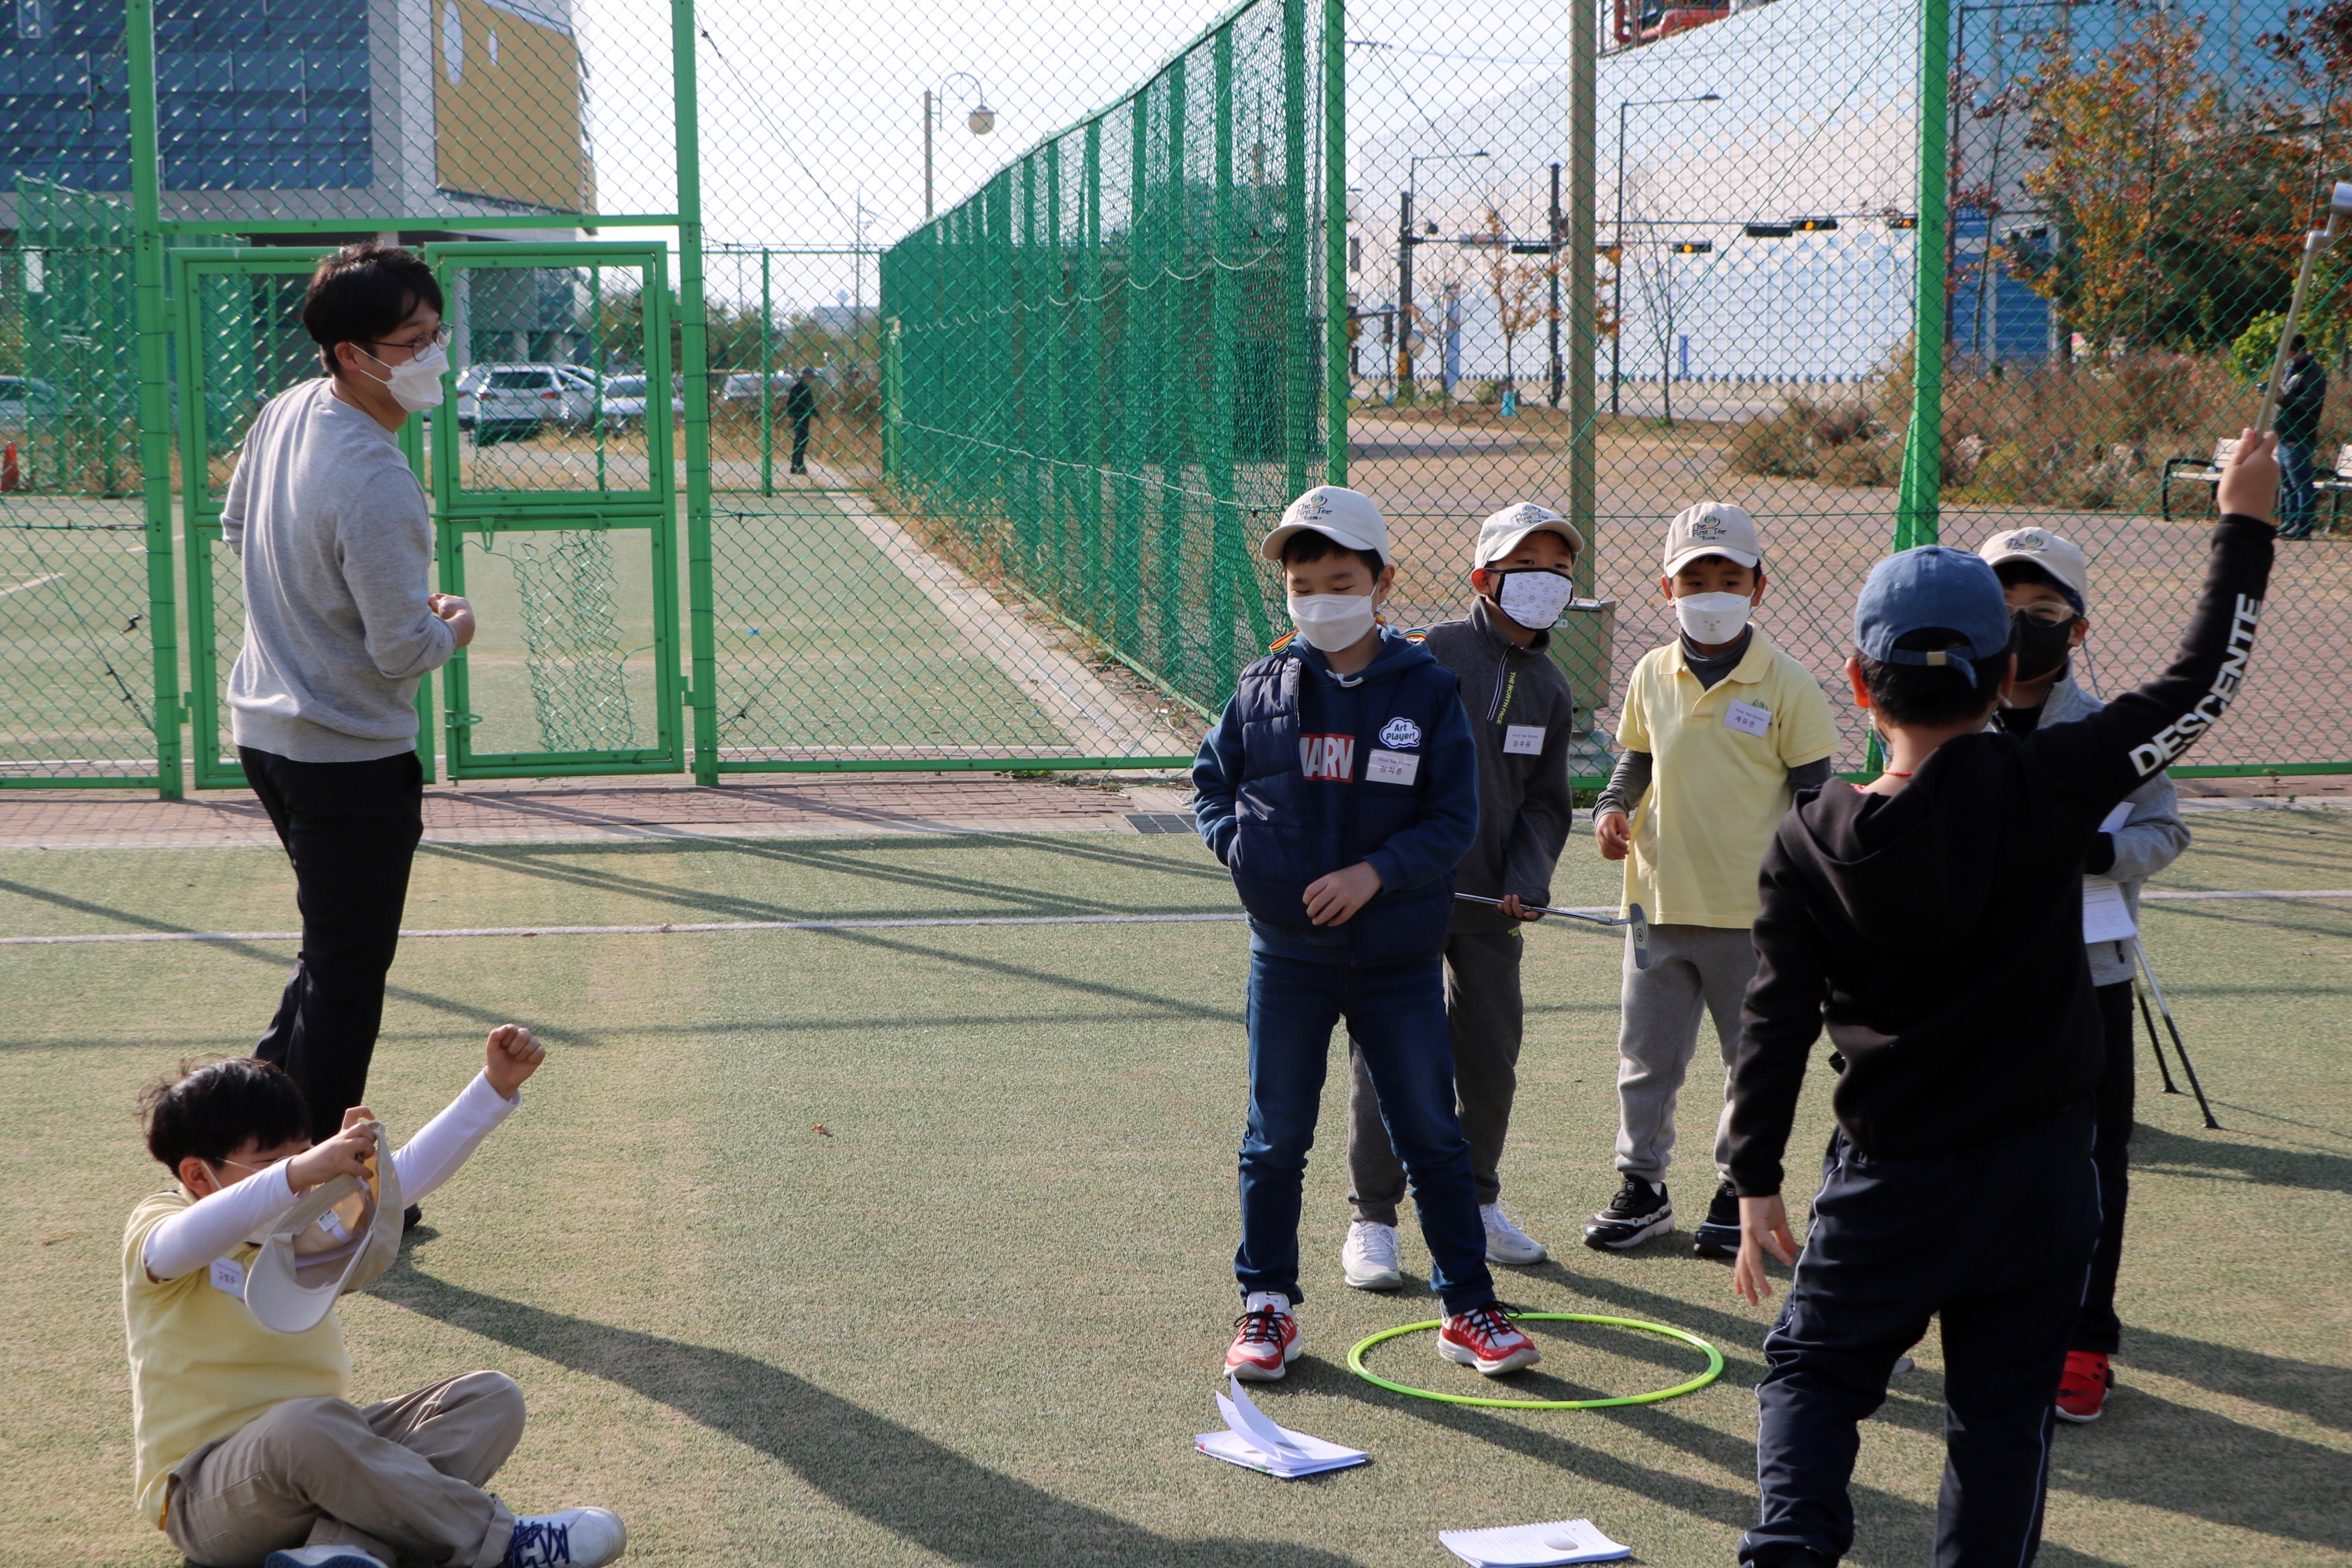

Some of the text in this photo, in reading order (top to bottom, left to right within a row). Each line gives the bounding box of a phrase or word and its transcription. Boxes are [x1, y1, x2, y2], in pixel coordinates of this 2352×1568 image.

[1317, 506, 1333, 515] Tee
[2128, 593, 2262, 777] DESCENTE
[1503, 684, 1514, 708] NORTH
[1496, 707, 1506, 725] FACE
[1386, 731, 1415, 742] Player!
